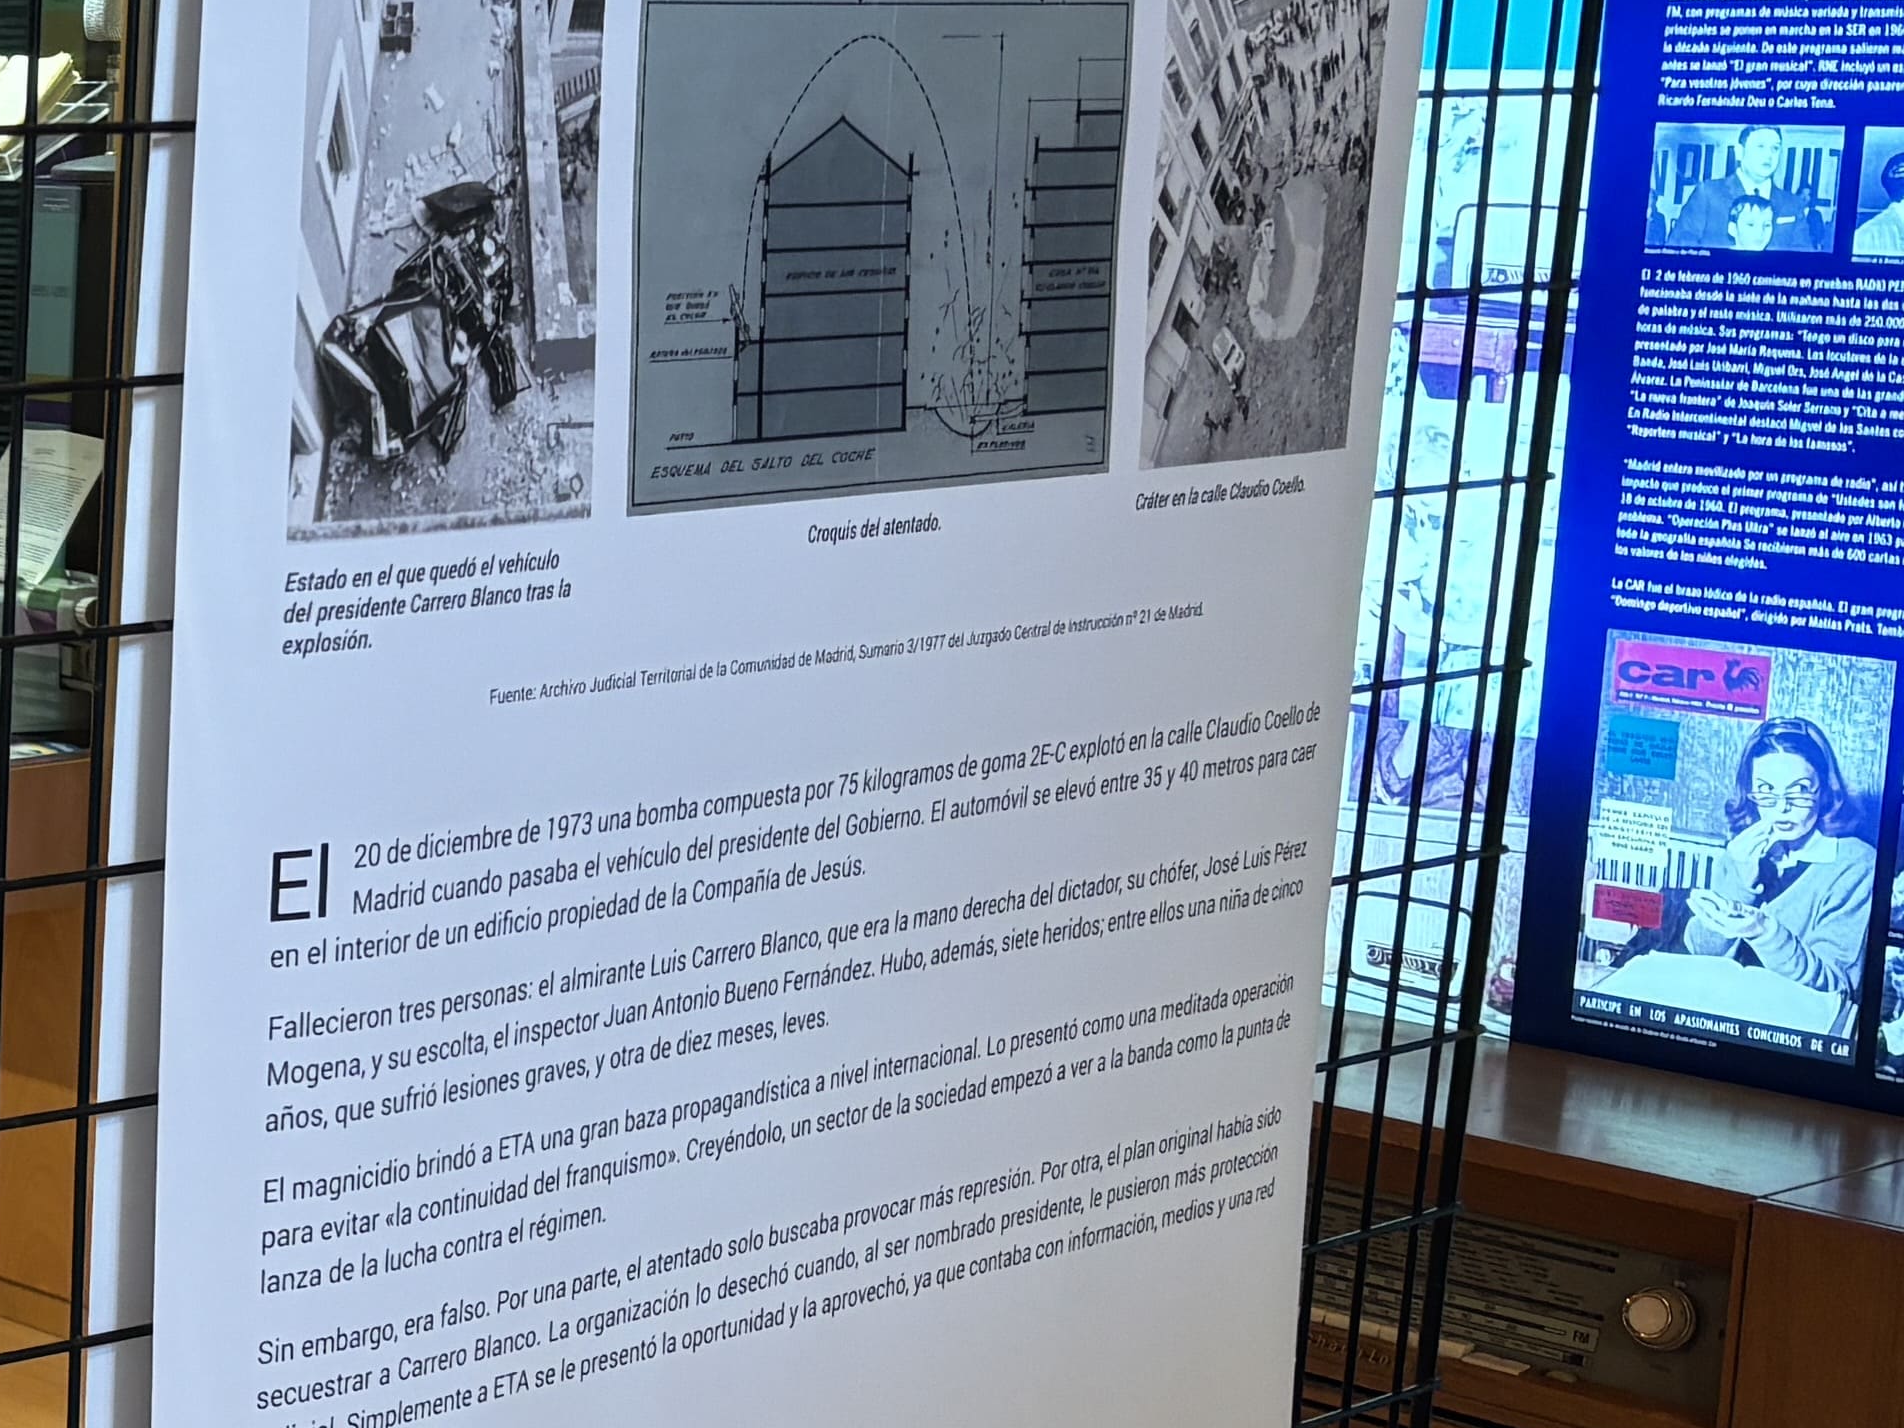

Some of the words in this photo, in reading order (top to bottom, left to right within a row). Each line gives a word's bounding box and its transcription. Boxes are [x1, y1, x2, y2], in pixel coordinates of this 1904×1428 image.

[650, 455, 711, 479] ESQUEMA
[720, 459, 744, 474] DEL
[750, 455, 792, 471] SALTO
[800, 453, 823, 467] DEL
[832, 447, 876, 463] COCHE
[1135, 491, 1170, 511] Cráter
[1172, 492, 1186, 507] en
[1188, 486, 1199, 505] la
[1200, 483, 1227, 503] calle
[1229, 479, 1270, 500] Claudio
[808, 519, 856, 546] Croquis
[860, 516, 880, 538] del
[882, 512, 940, 535] atentado.
[284, 568, 347, 592] Estado
[352, 571, 372, 587] en
[377, 563, 393, 586] el
[396, 567, 425, 589] que
[429, 556, 476, 586] quedó
[480, 554, 495, 576] el
[498, 548, 559, 574] vehículo
[283, 600, 313, 623] del
[315, 596, 406, 627] presidente
[410, 593, 466, 613] Carrero
[470, 585, 522, 607] Blanco
[526, 583, 554, 602] tras
[558, 577, 571, 598] la
[282, 629, 372, 659] explosión.
[1618, 660, 1715, 689] car
[270, 842, 328, 922] El
[354, 842, 380, 868] 20
[387, 837, 411, 864] de
[416, 825, 512, 860] diciembre
[517, 818, 540, 844] de
[548, 811, 592, 840] 1973
[598, 811, 631, 833] una
[636, 796, 698, 826] bomba
[703, 783, 800, 817] compuesta
[804, 780, 834, 808] por
[838, 771, 859, 796] 75
[862, 762, 954, 794] kilogramos
[958, 753, 977, 778] de
[981, 751, 1026, 780] goma
[1029, 741, 1066, 767] 2E-C
[1069, 731, 1125, 764] explotó
[1128, 733, 1146, 751] en
[1150, 726, 1163, 748] la
[1167, 719, 1202, 746] calle
[1206, 711, 1260, 740] Claudio
[1264, 705, 1304, 730] Coello
[1306, 700, 1320, 723] de
[1580, 995, 1621, 1014] PARTICIPE
[1629, 1004, 1641, 1017] EN
[1650, 1008, 1666, 1022] LOS
[1674, 1013, 1739, 1035] APASIONANTES
[1747, 1026, 1801, 1047] CONCURSOS
[1810, 1038, 1823, 1052] DE
[1830, 1042, 1849, 1056] CAR
